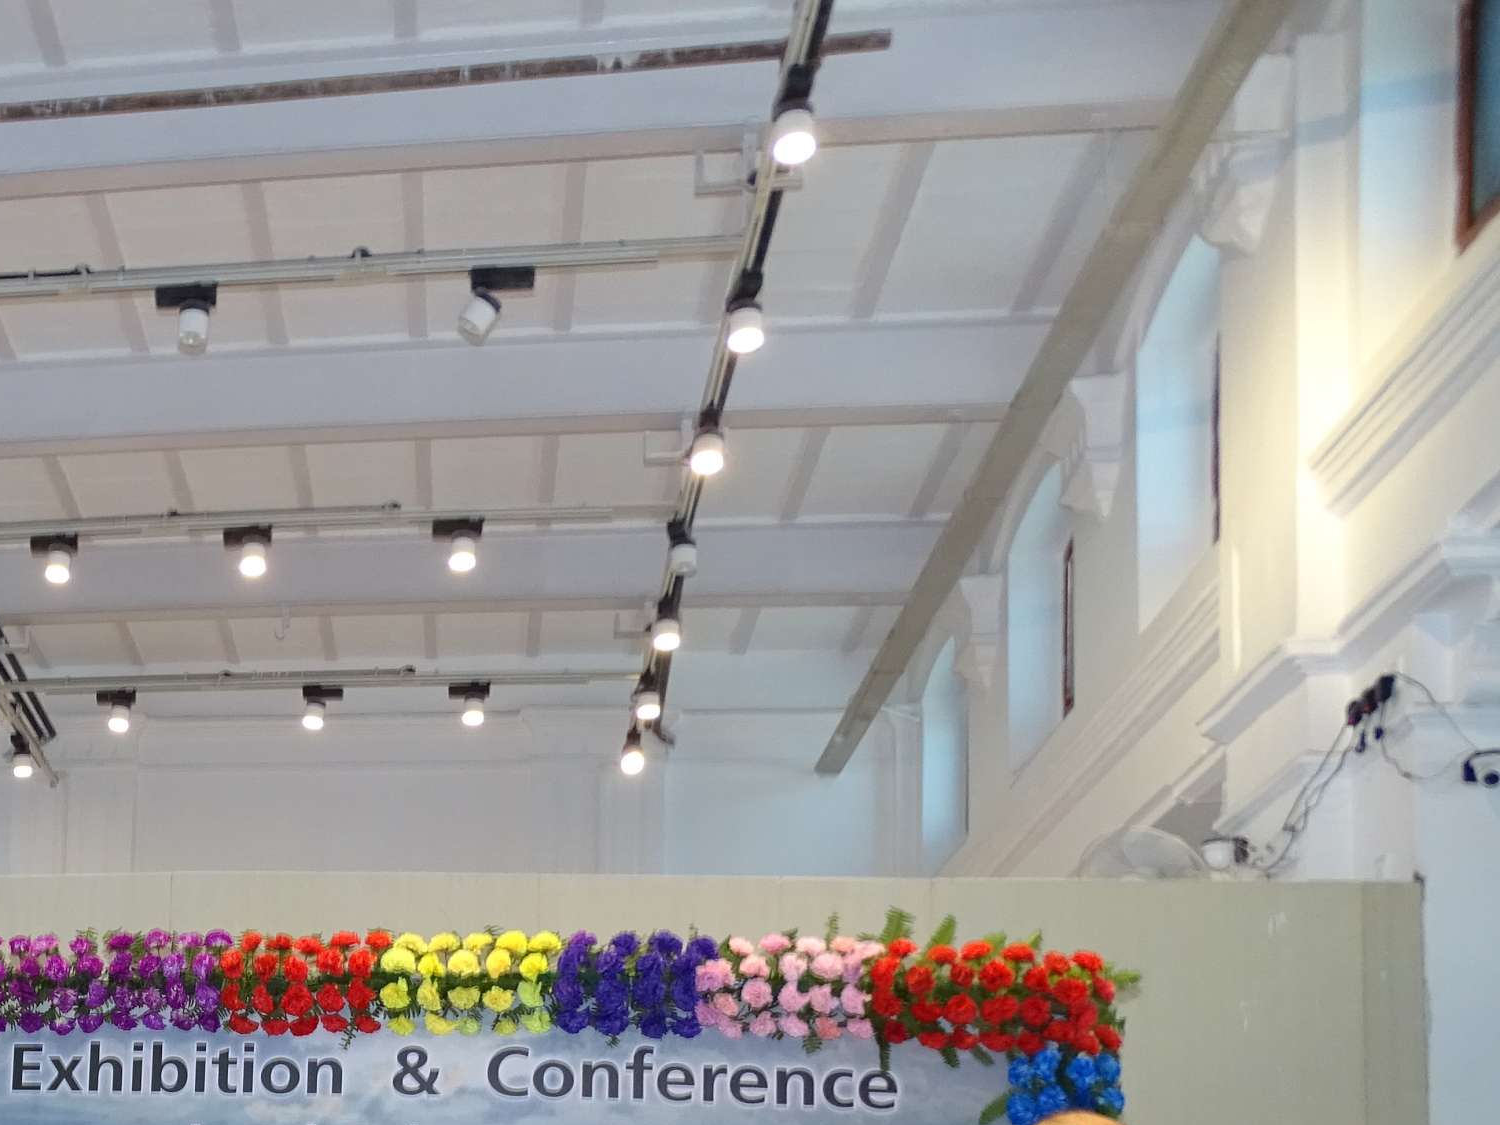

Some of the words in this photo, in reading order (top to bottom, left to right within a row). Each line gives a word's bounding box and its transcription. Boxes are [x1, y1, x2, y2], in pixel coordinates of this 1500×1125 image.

[11, 1043, 343, 1095] Exhibition
[392, 1045, 440, 1096] &
[487, 1045, 898, 1109] Conference
